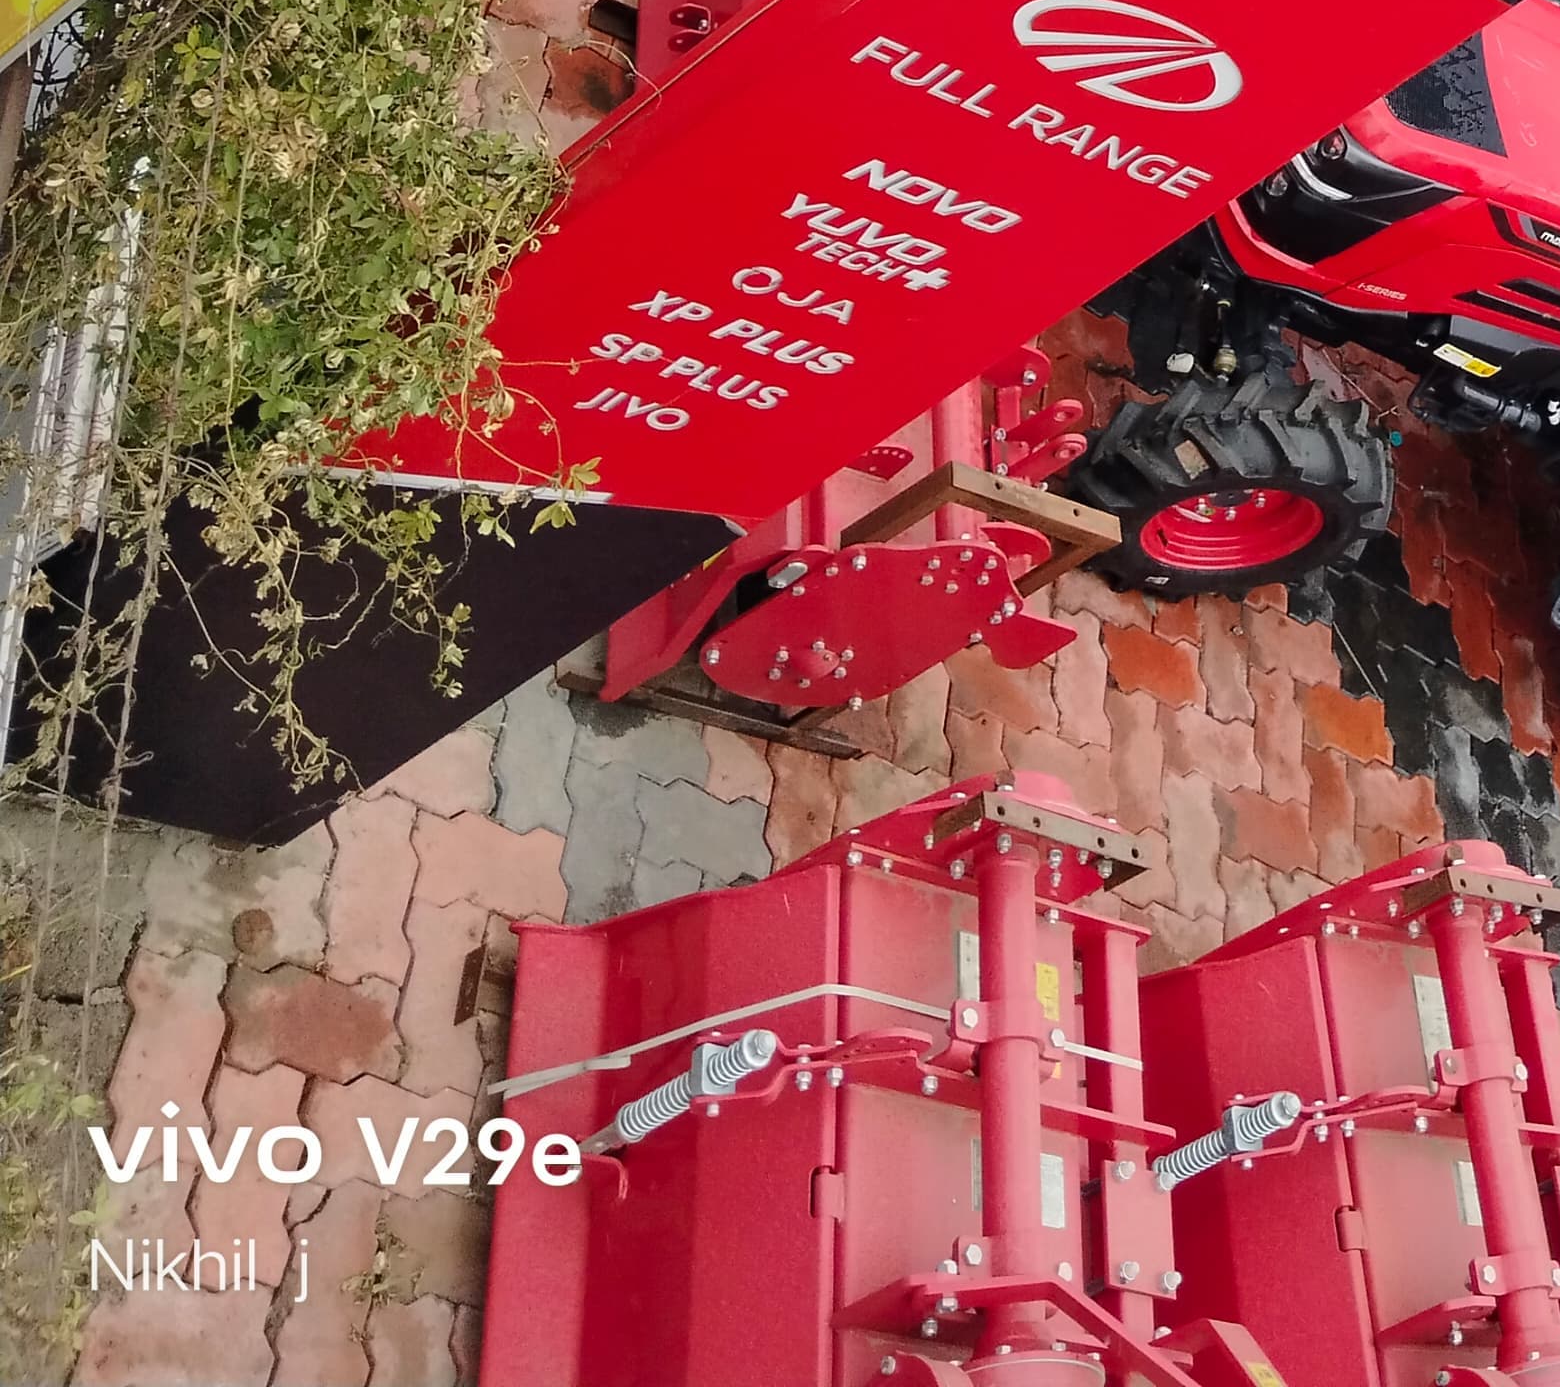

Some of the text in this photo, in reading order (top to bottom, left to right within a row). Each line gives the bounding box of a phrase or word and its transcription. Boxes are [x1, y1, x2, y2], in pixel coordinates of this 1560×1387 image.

[850, 36, 1214, 199] FULL RANGE
[779, 193, 950, 268] YUVO
[842, 159, 1022, 234] NOVO
[628, 290, 856, 375] XP PLUS
[731, 266, 858, 325] OJA
[574, 387, 691, 432] JIVO
[590, 333, 790, 412] SP PLUS
